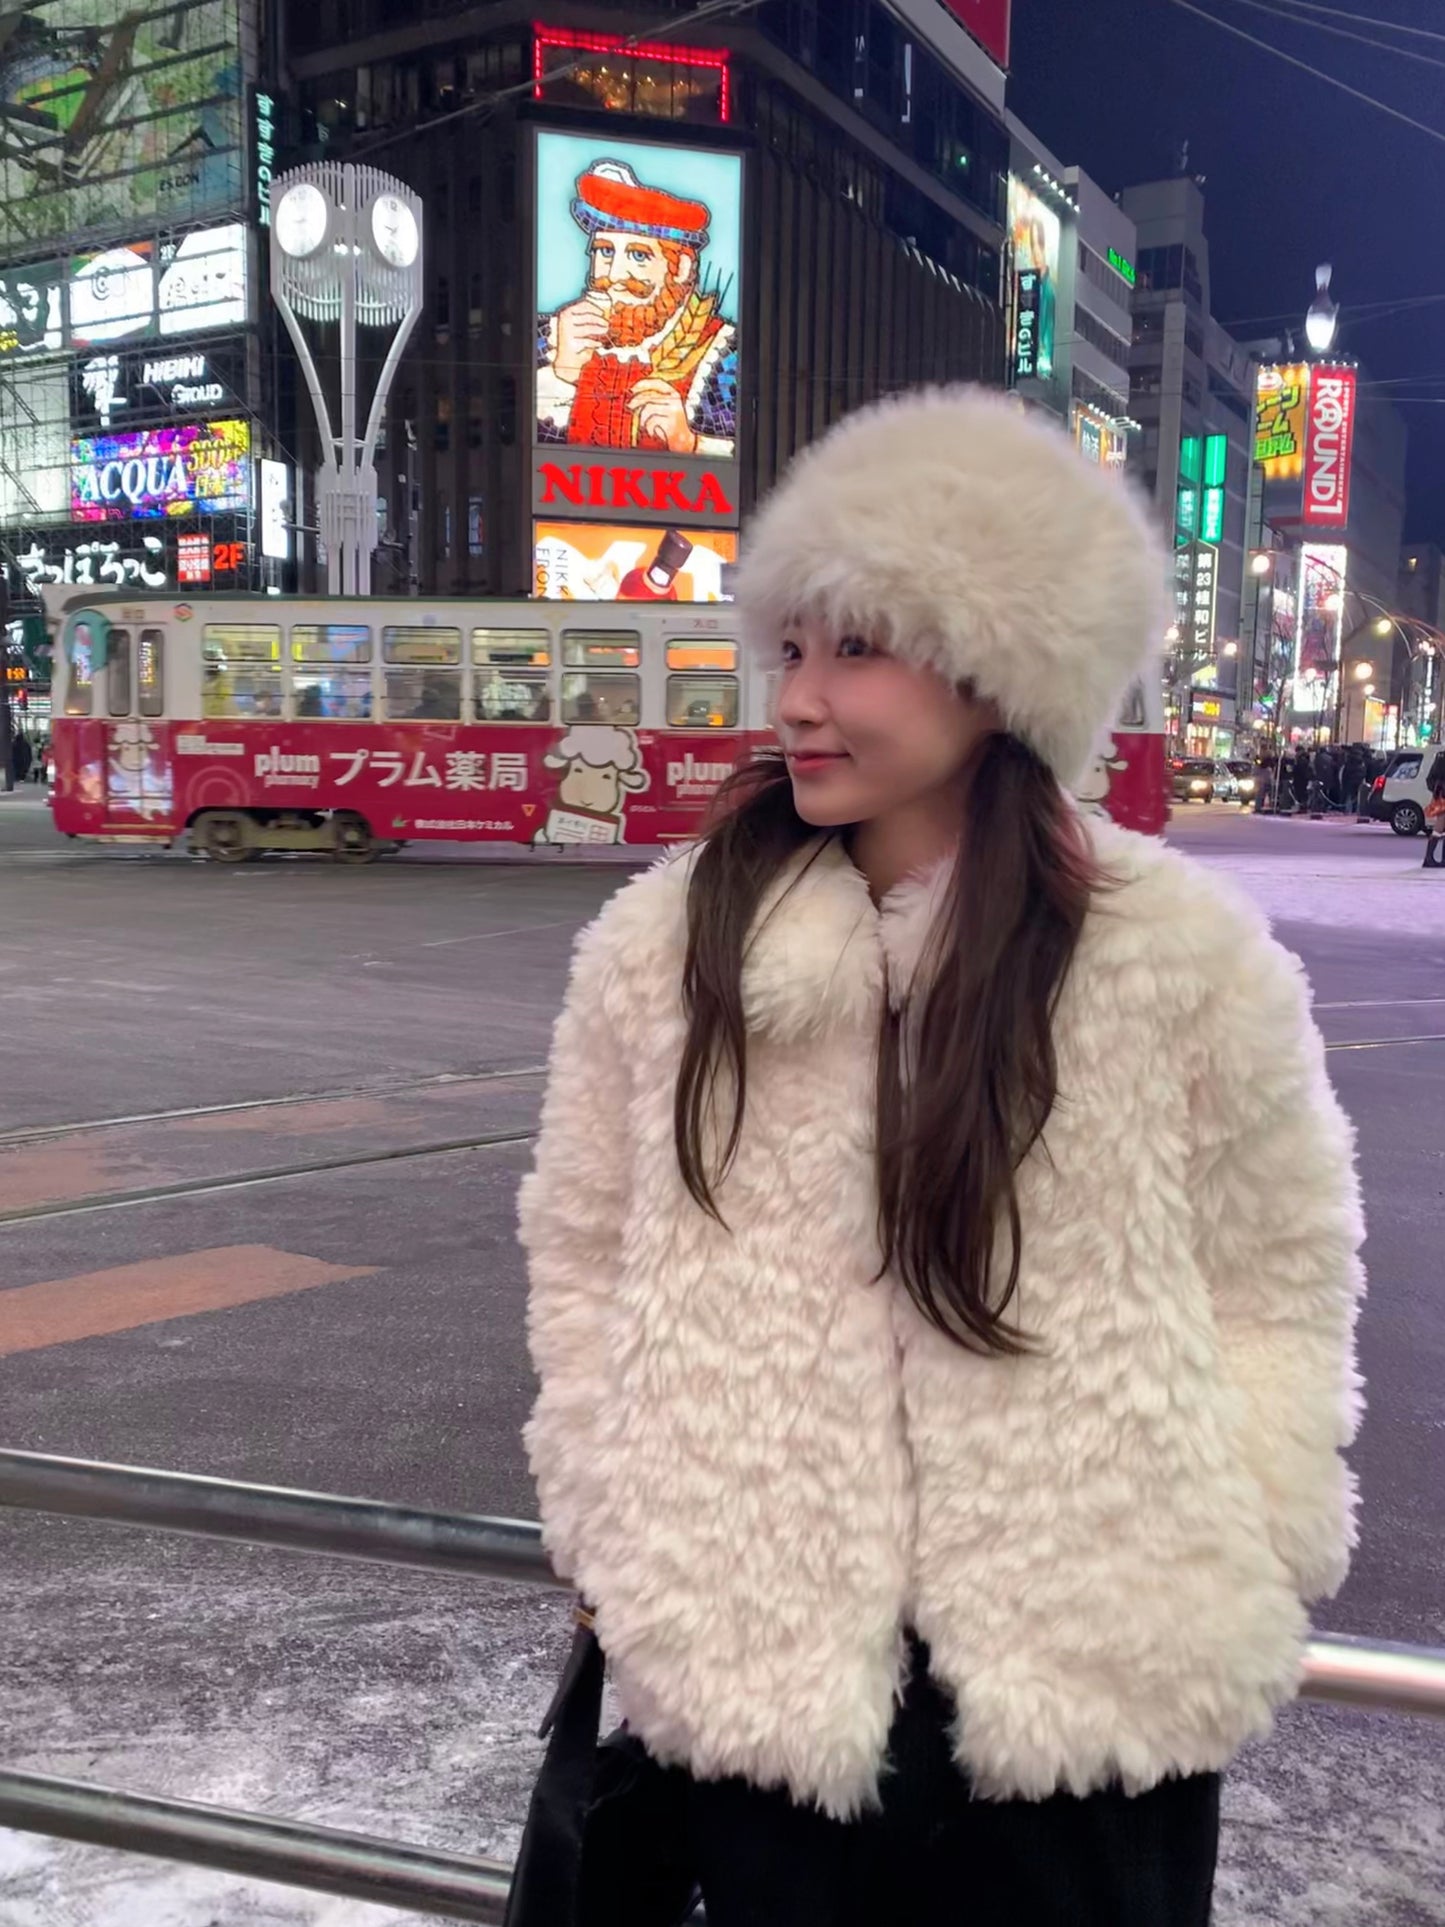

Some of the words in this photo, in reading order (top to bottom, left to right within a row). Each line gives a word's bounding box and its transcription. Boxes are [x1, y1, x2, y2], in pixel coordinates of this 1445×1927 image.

[1310, 377, 1344, 515] ROUND1
[79, 455, 188, 504] ACQUA
[540, 463, 733, 515] NIKKA
[213, 542, 245, 570] 2F
[254, 746, 320, 777] plum
[330, 749, 529, 792] プラム薬局
